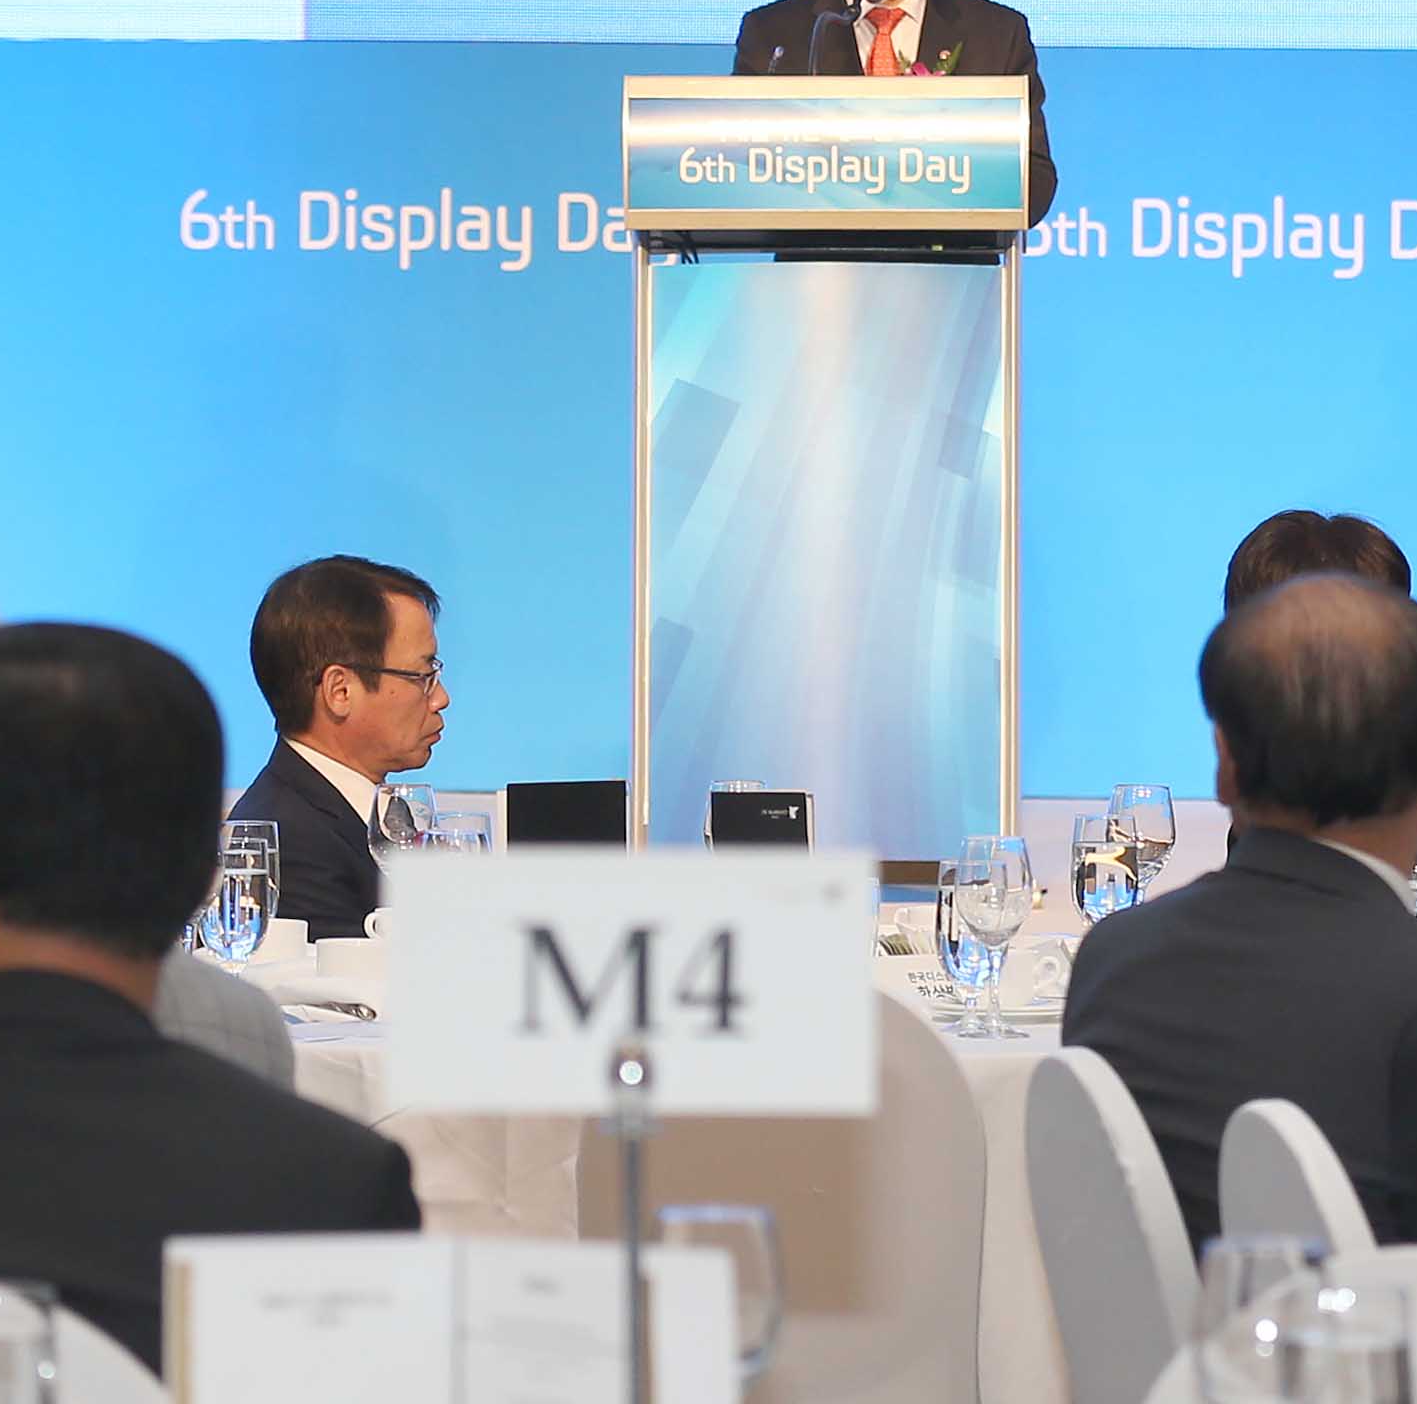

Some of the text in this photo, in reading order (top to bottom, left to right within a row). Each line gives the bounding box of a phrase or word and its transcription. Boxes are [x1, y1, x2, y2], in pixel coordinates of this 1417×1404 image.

[679, 145, 971, 195] 6th Display Day
[179, 189, 275, 251] 6th
[298, 187, 533, 272] Display
[1131, 195, 1365, 279] Display
[516, 920, 748, 1038] M4
